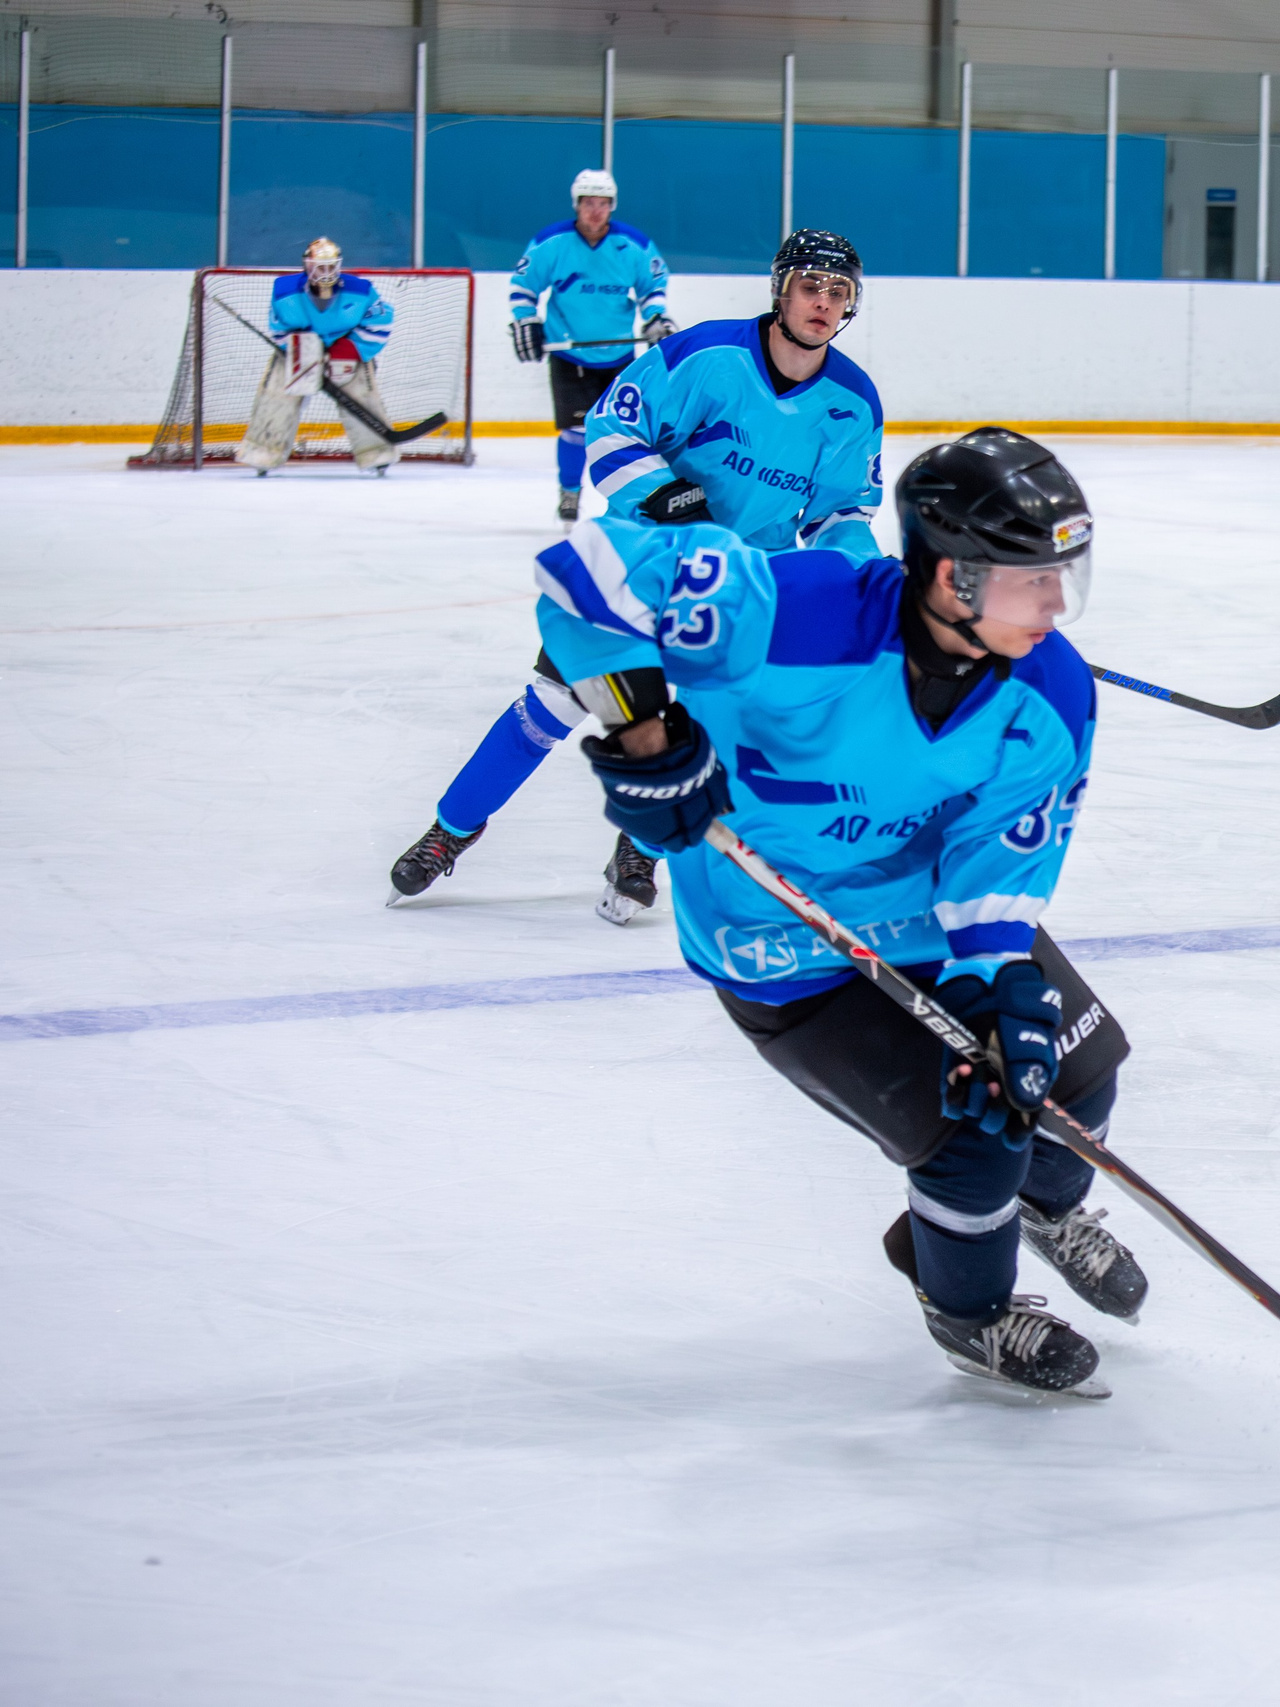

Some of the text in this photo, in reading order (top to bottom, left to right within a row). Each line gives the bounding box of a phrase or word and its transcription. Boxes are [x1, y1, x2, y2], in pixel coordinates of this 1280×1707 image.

[594, 376, 642, 425] 18
[721, 450, 755, 477] АО
[1101, 669, 1175, 702] PRIME
[818, 814, 872, 844] АО
